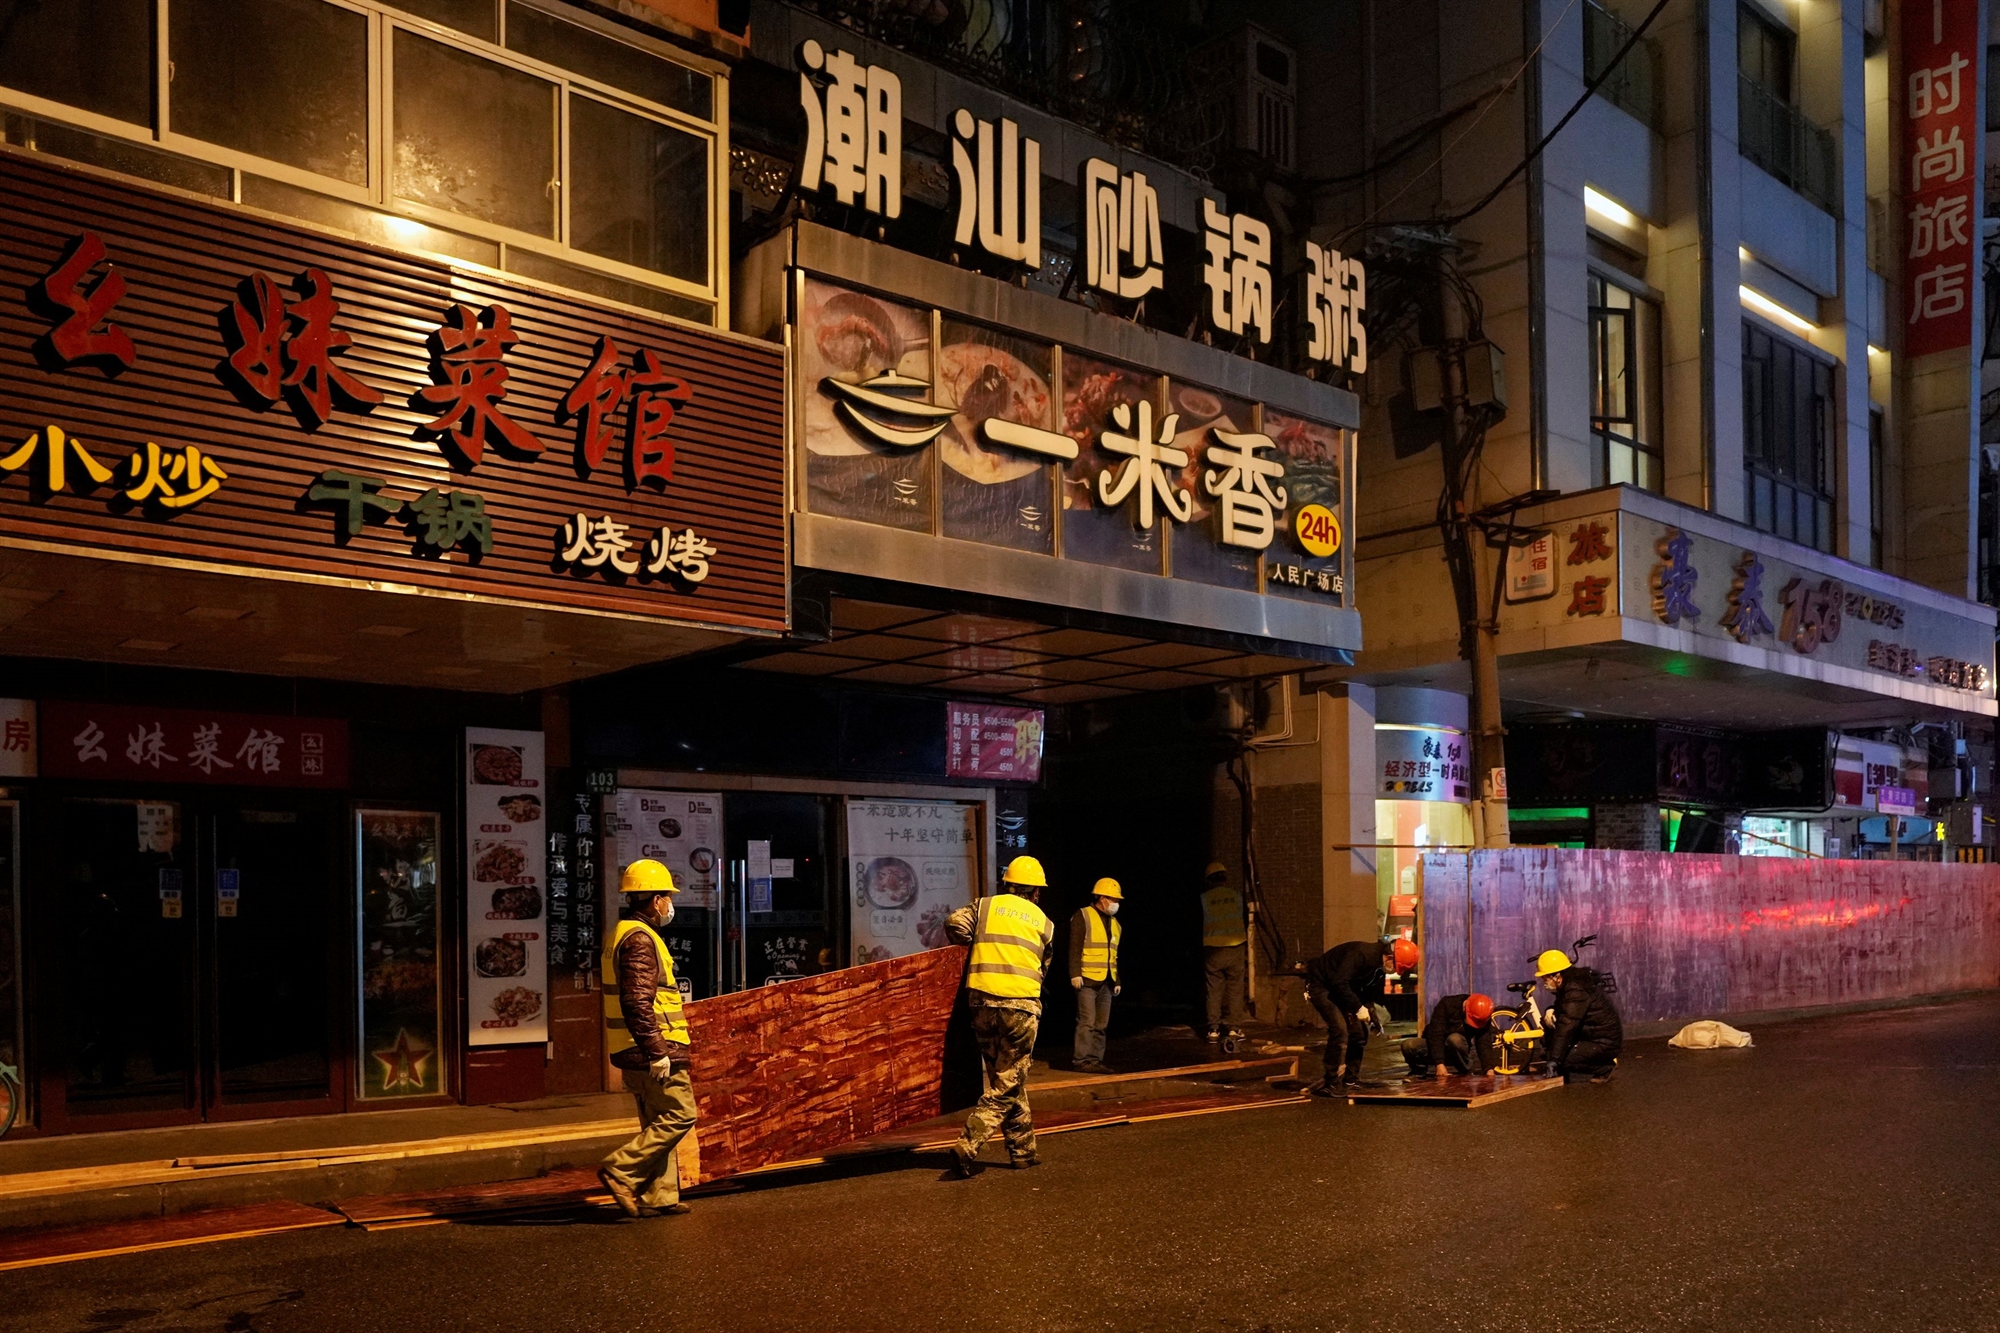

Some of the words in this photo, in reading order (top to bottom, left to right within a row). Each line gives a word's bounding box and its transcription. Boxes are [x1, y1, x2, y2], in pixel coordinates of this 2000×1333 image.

[799, 39, 1367, 376] 潮汕砂锅粥
[0, 426, 228, 509] 小炒
[980, 400, 1290, 550] 一米香
[309, 469, 494, 555] 干锅
[1300, 509, 1339, 546] 24h
[560, 511, 718, 583] 烧烤
[1531, 540, 1548, 572] 住宿
[1273, 563, 1344, 594] 人民广场店
[1567, 521, 1614, 618] 旅店
[3, 718, 31, 753] 房
[953, 711, 980, 727] 服务员
[983, 716, 1016, 727] 4500-5500
[72, 719, 286, 776] 幺妹菜馆
[999, 747, 1014, 757] 4500
[1014, 712, 1042, 771] 聘
[590, 772, 614, 786] 103
[999, 762, 1014, 772] 4500
[641, 798, 649, 812] B
[689, 800, 697, 814] D
[642, 844, 650, 858] C
[885, 827, 974, 844] 十年坚守简单
[548, 832, 569, 966] 传承爱与美食
[573, 792, 598, 992] 专属你的砂锅粥订制
